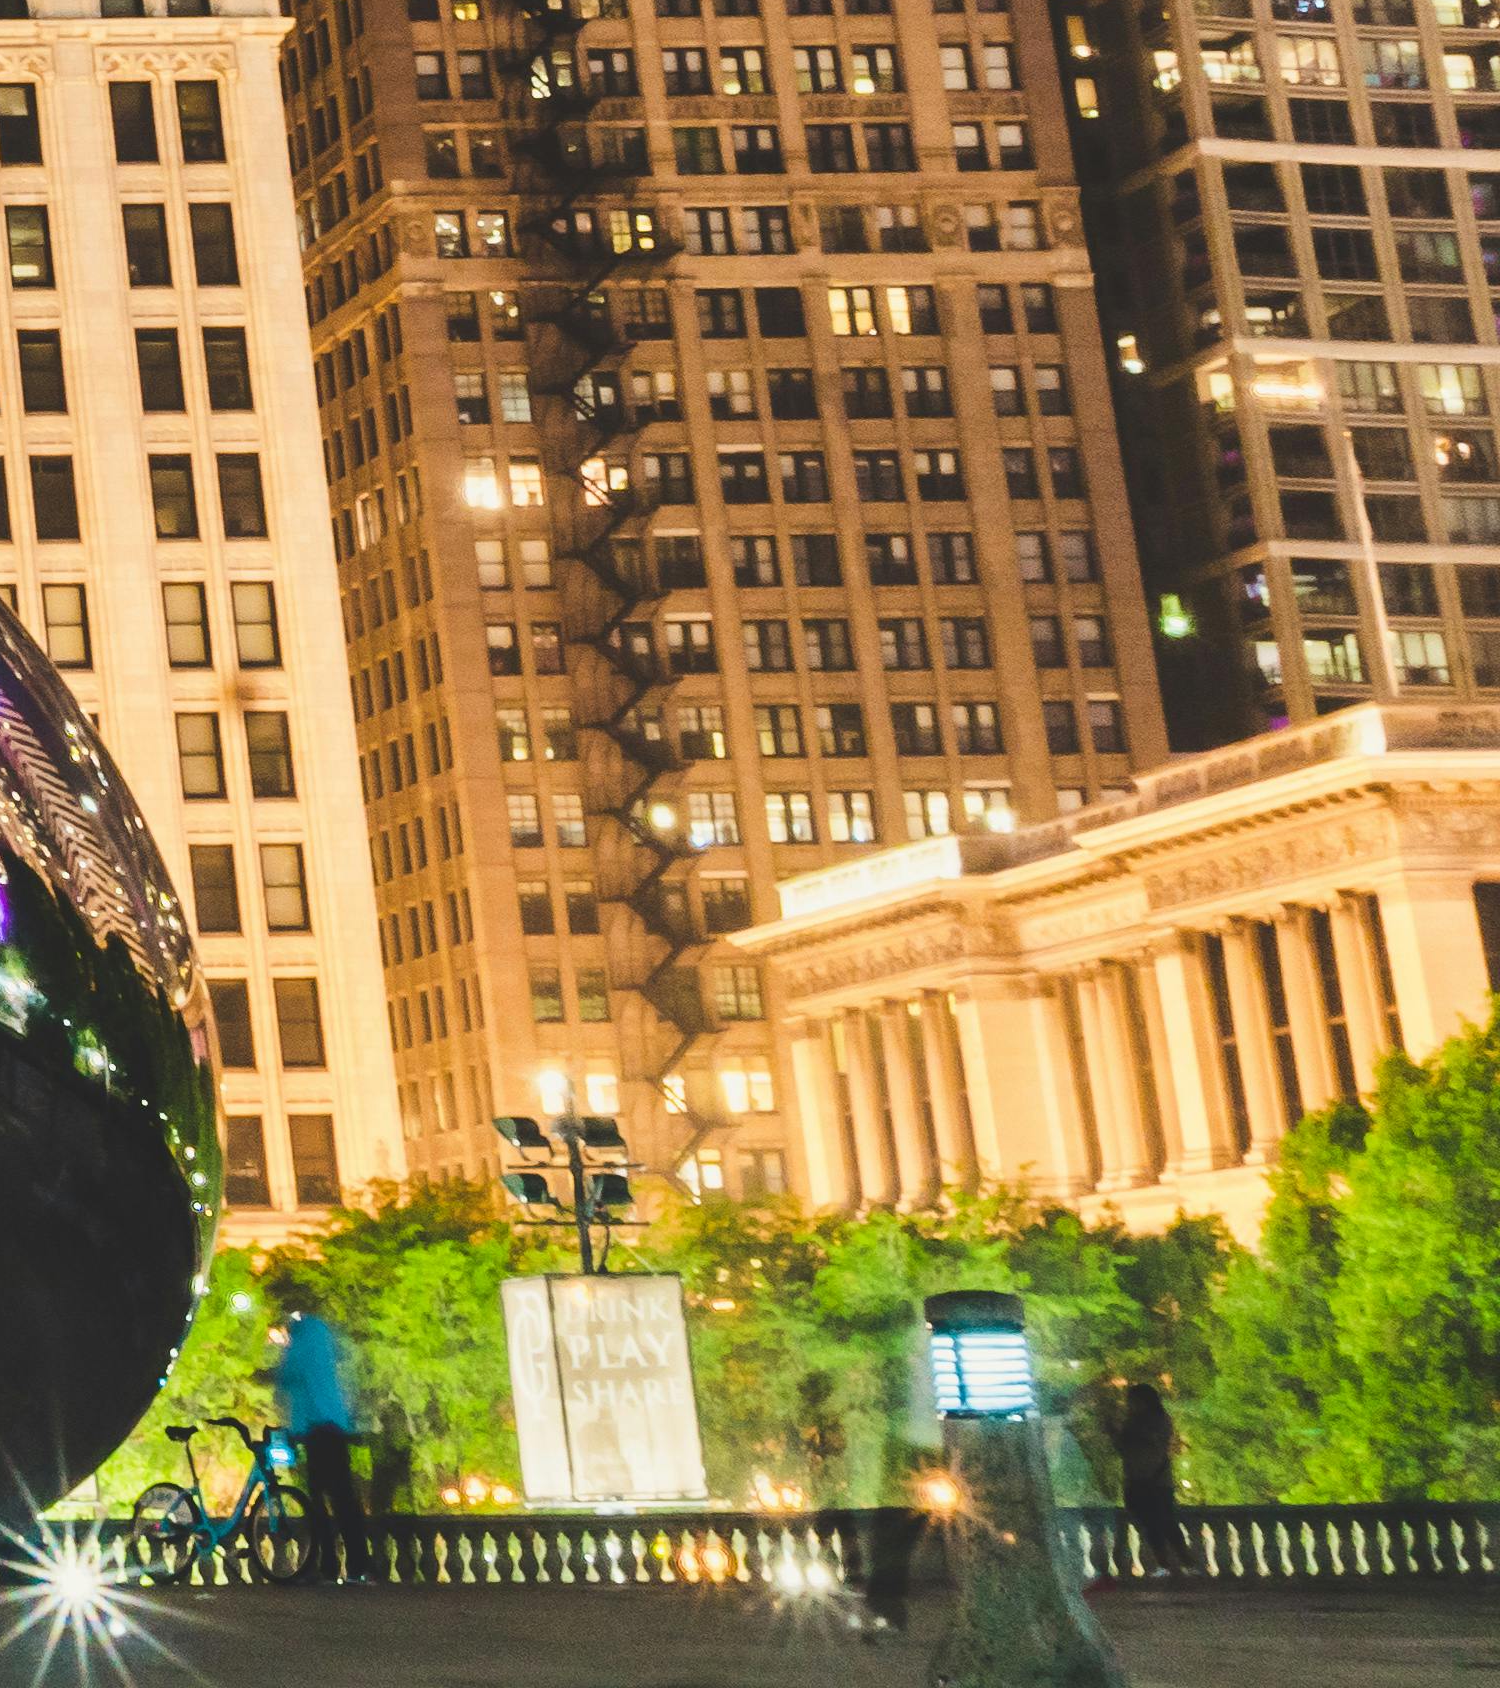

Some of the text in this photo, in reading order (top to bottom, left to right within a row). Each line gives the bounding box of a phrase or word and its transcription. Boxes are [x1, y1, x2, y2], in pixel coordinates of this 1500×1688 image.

[563, 1296, 670, 1322] DRINK
[569, 1331, 677, 1369] PLAY
[572, 1378, 685, 1408] SHARE
